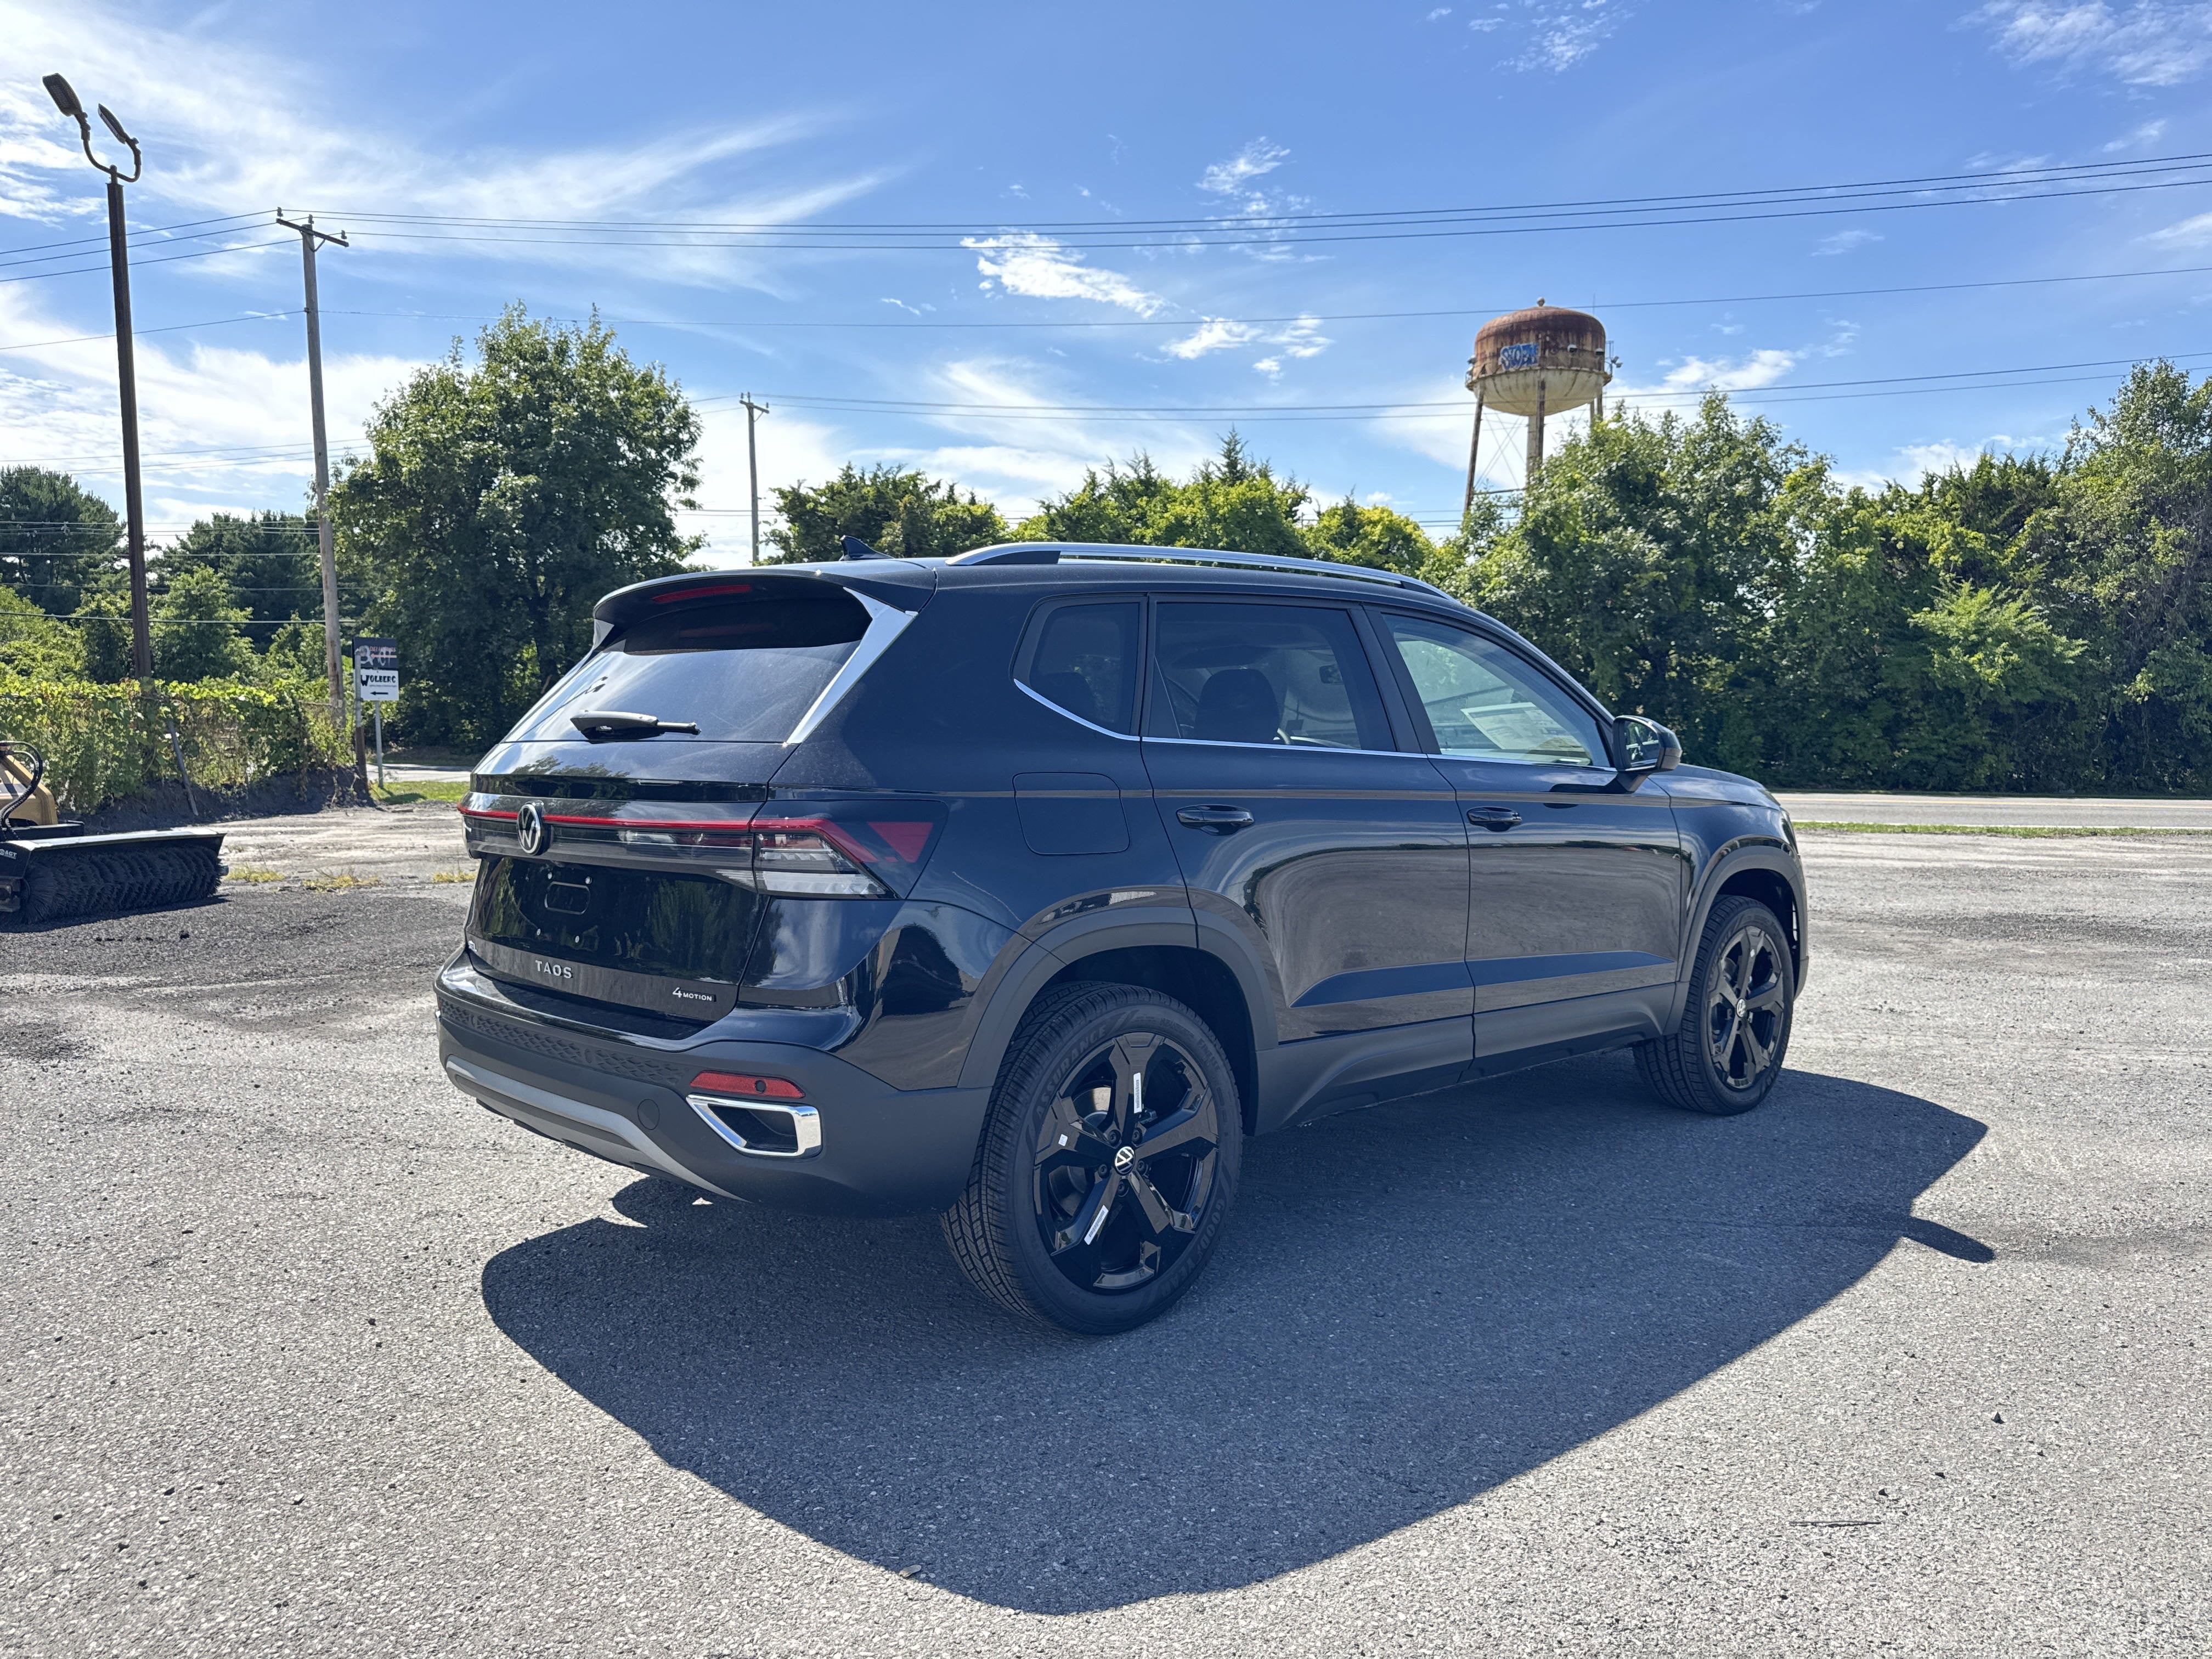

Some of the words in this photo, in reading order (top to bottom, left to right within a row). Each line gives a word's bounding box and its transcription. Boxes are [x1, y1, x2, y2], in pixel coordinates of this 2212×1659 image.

[535, 960, 572, 979] TAOS
[673, 988, 712, 1001] 4MOTION
[1036, 1025, 1107, 1120] ASSURANCE
